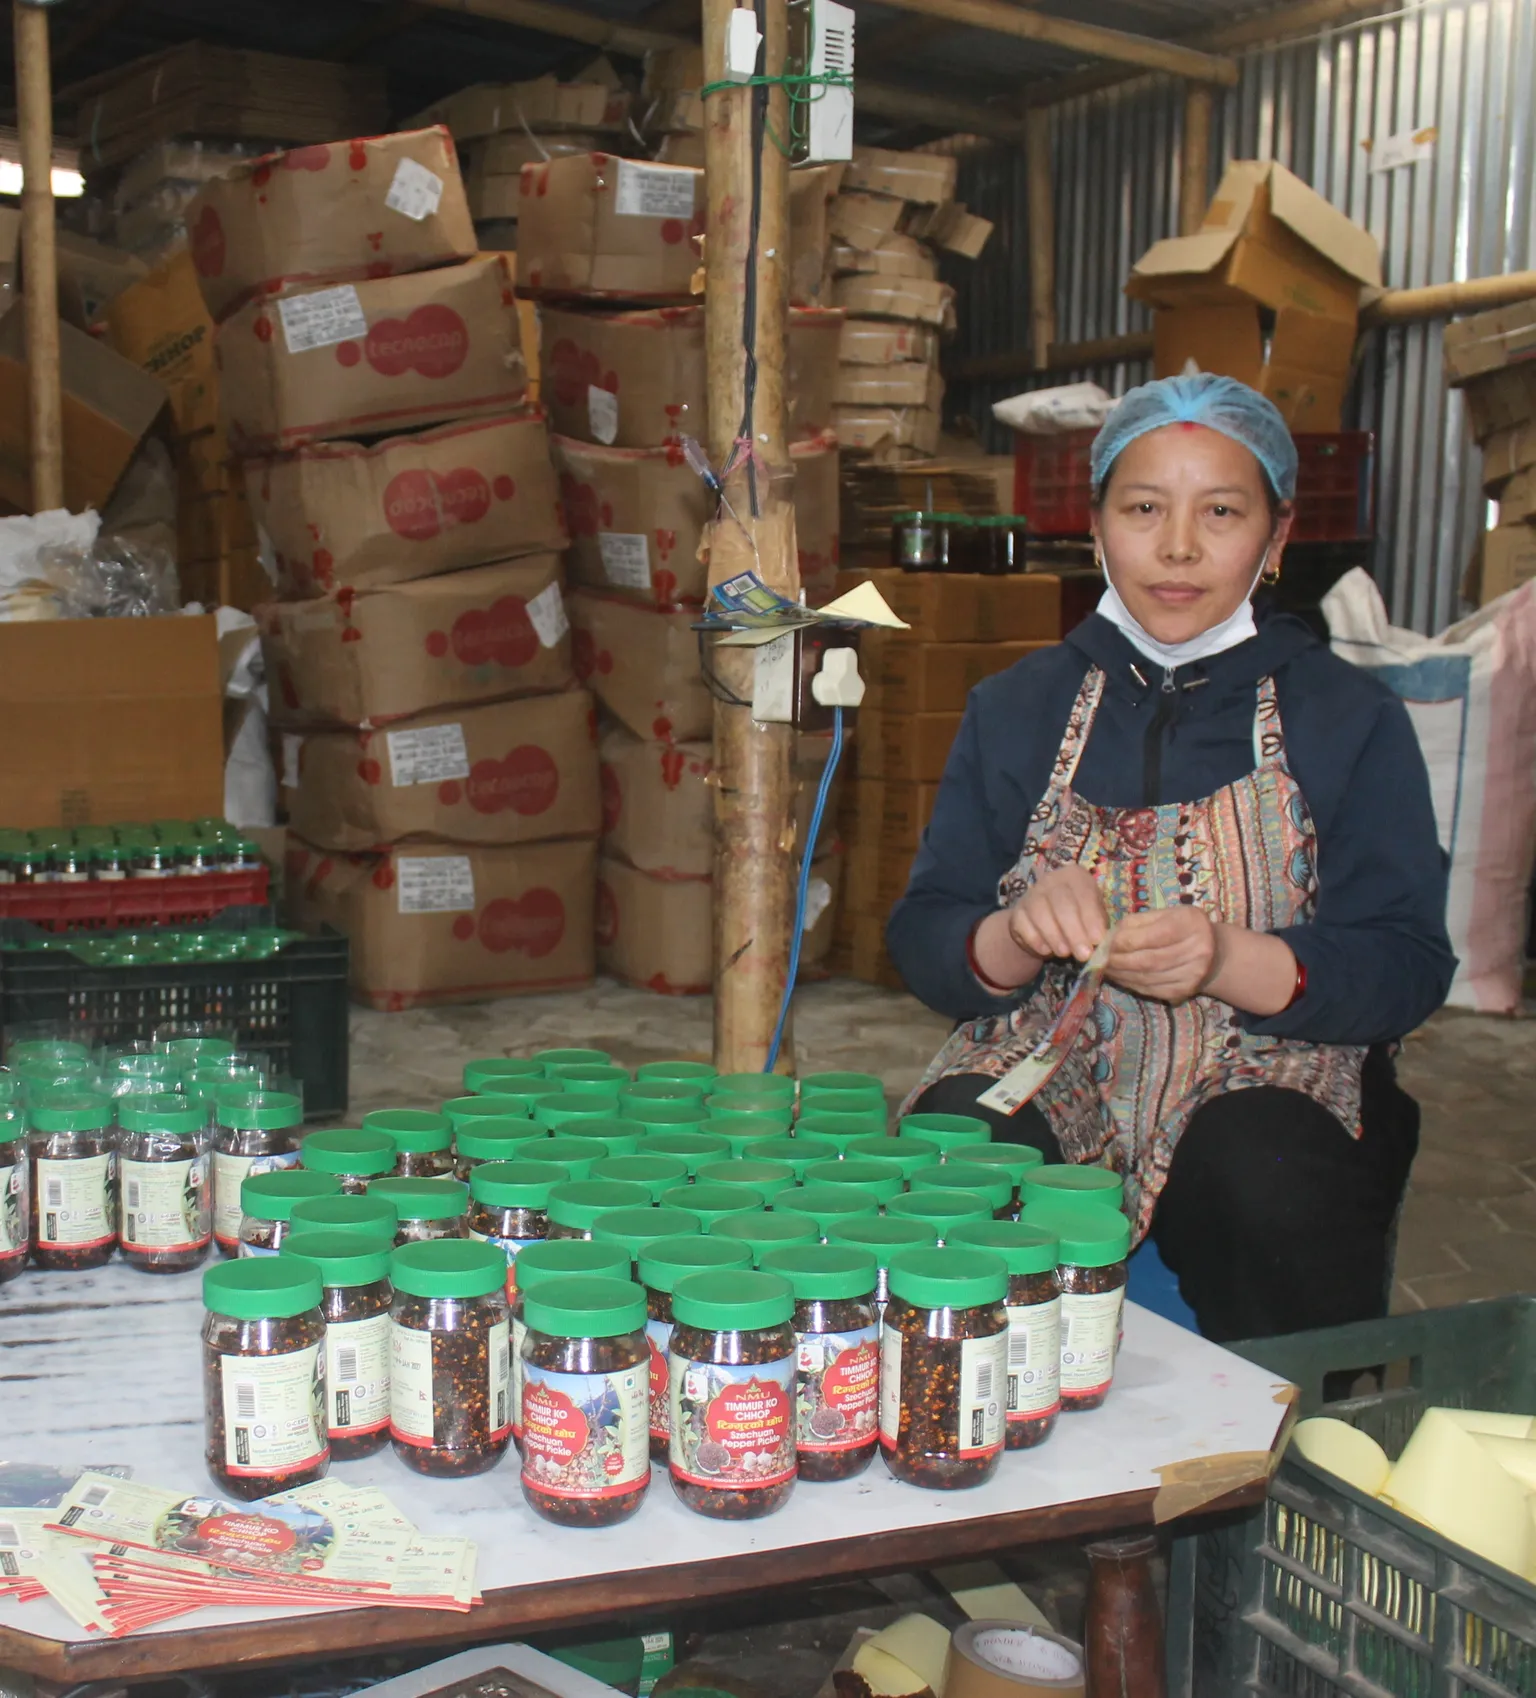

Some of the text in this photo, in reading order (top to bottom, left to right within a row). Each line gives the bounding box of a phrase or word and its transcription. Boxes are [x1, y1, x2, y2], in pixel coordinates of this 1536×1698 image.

[840, 1362, 869, 1376] TIMMUR
[531, 1394, 558, 1408] NMU
[736, 1392, 770, 1400] NMU
[725, 1398, 777, 1411] TIMMUR KO
[530, 1412, 559, 1428] CHHOP
[553, 1409, 568, 1419] KO
[735, 1410, 770, 1420] CHHOP
[730, 1428, 774, 1440] Szechuan
[722, 1435, 780, 1449] Pepper Pickle
[546, 1444, 572, 1456] Pickle
[222, 1520, 263, 1532] TIMMUR
